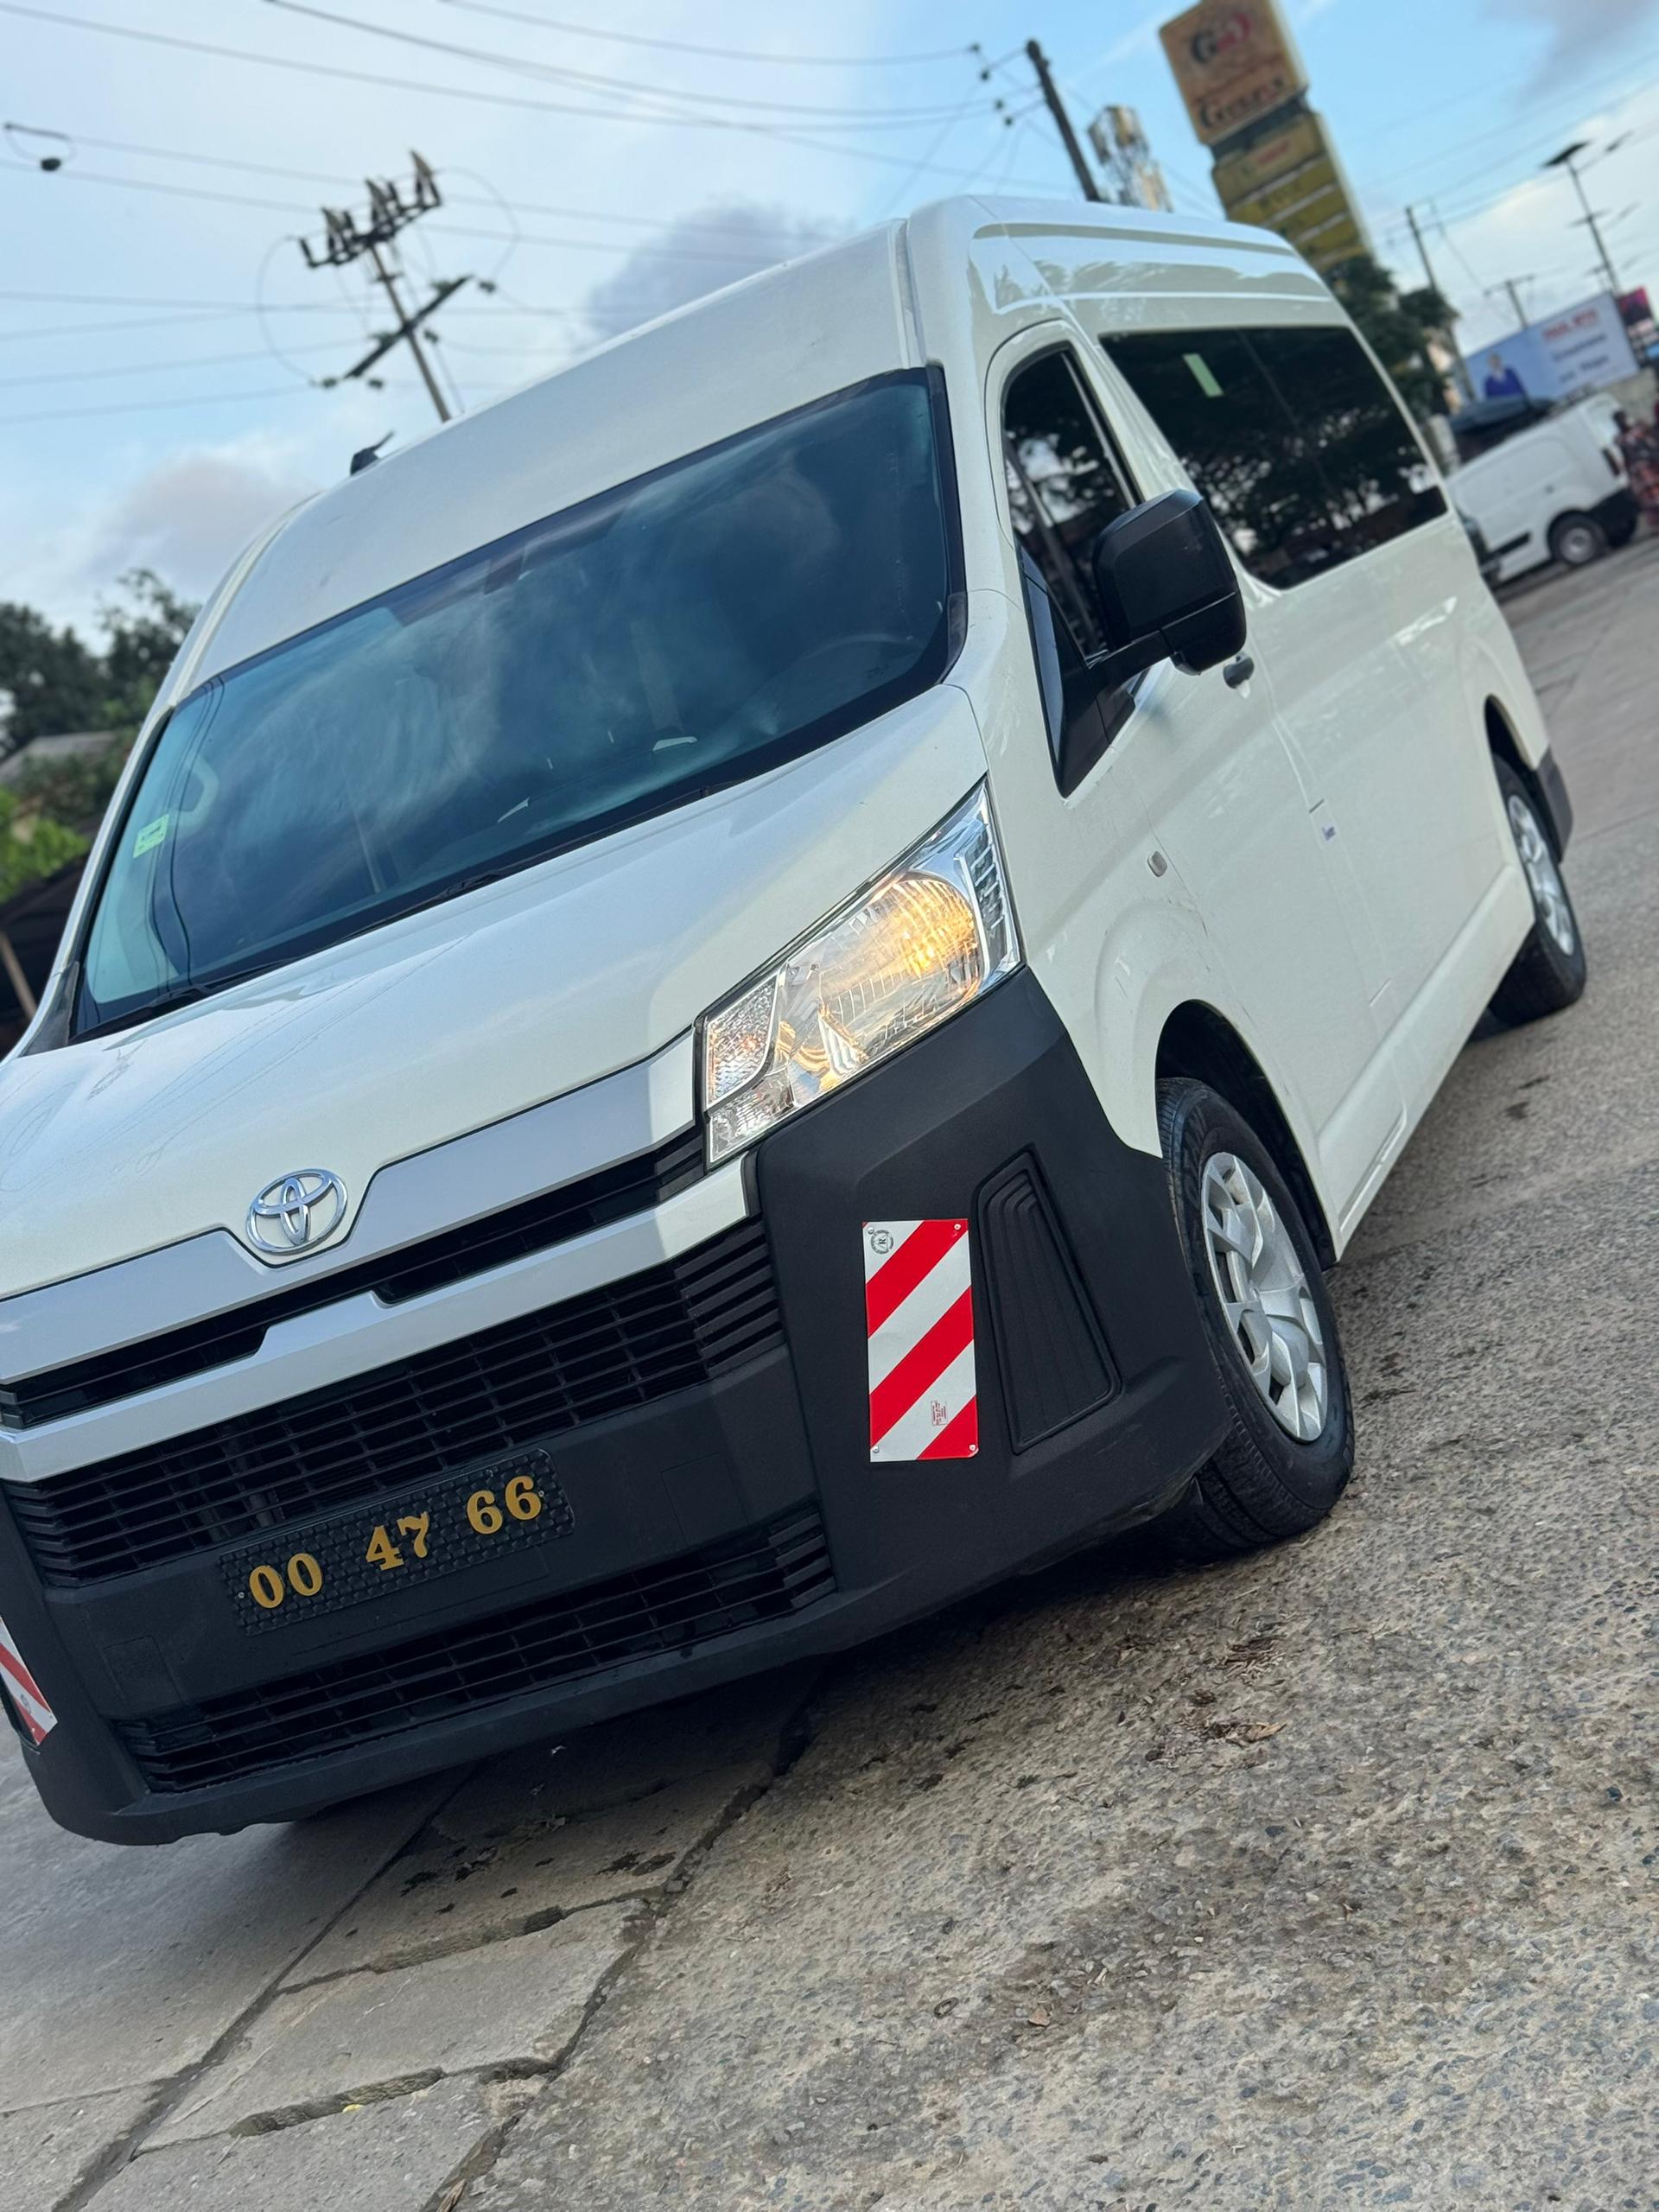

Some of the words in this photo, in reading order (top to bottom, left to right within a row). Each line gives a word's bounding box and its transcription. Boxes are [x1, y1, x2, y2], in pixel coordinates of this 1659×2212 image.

[249, 1553, 323, 1609] 00
[365, 1510, 430, 1571] 47
[467, 1475, 543, 1535] 66
